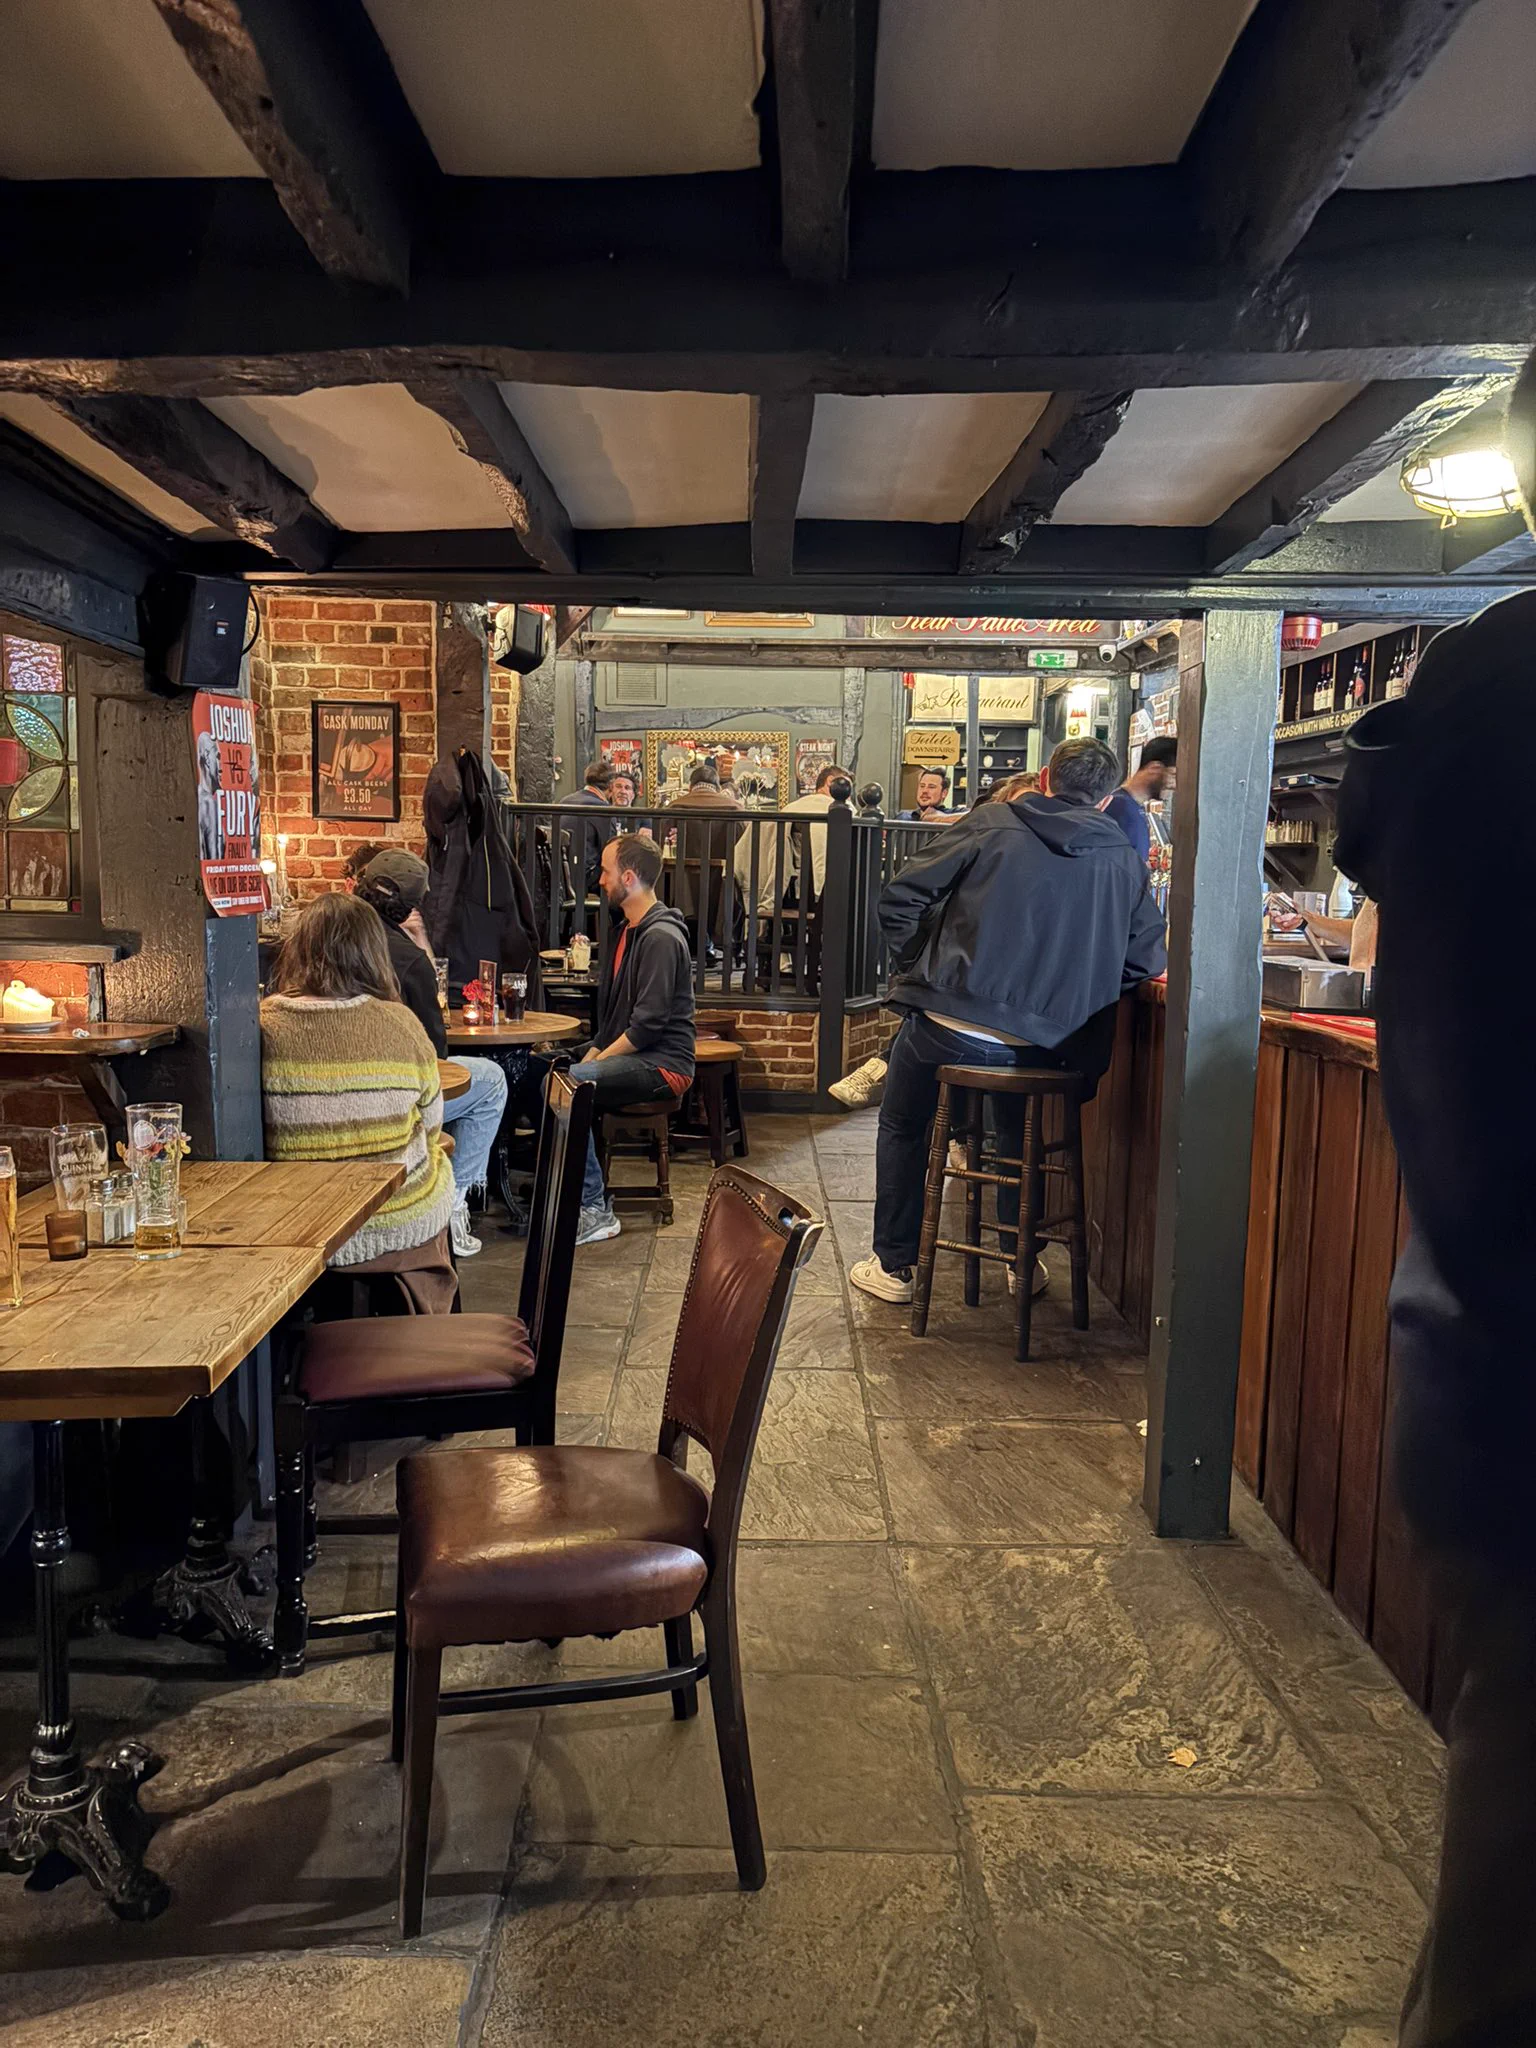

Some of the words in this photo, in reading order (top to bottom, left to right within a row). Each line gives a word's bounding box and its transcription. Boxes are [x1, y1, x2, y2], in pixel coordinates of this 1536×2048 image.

[938, 688, 1029, 709] Reurant
[210, 703, 253, 745] JOSHUA
[323, 715, 348, 730] CASK
[350, 715, 389, 731] MONDAY
[1275, 720, 1303, 740] OCCASION
[1303, 716, 1319, 734] WITH
[1319, 713, 1335, 731] WINE
[910, 732, 952, 745] Toilets
[907, 746, 956, 754] DOWNSTAIRS
[364, 780, 388, 788] BEERS
[343, 787, 371, 804] £3.50
[216, 789, 257, 836] FURY
[358, 804, 373, 812] DAY
[228, 842, 247, 859] FINALLY
[206, 865, 226, 875] FRIDAY
[226, 875, 237, 892] OUR
